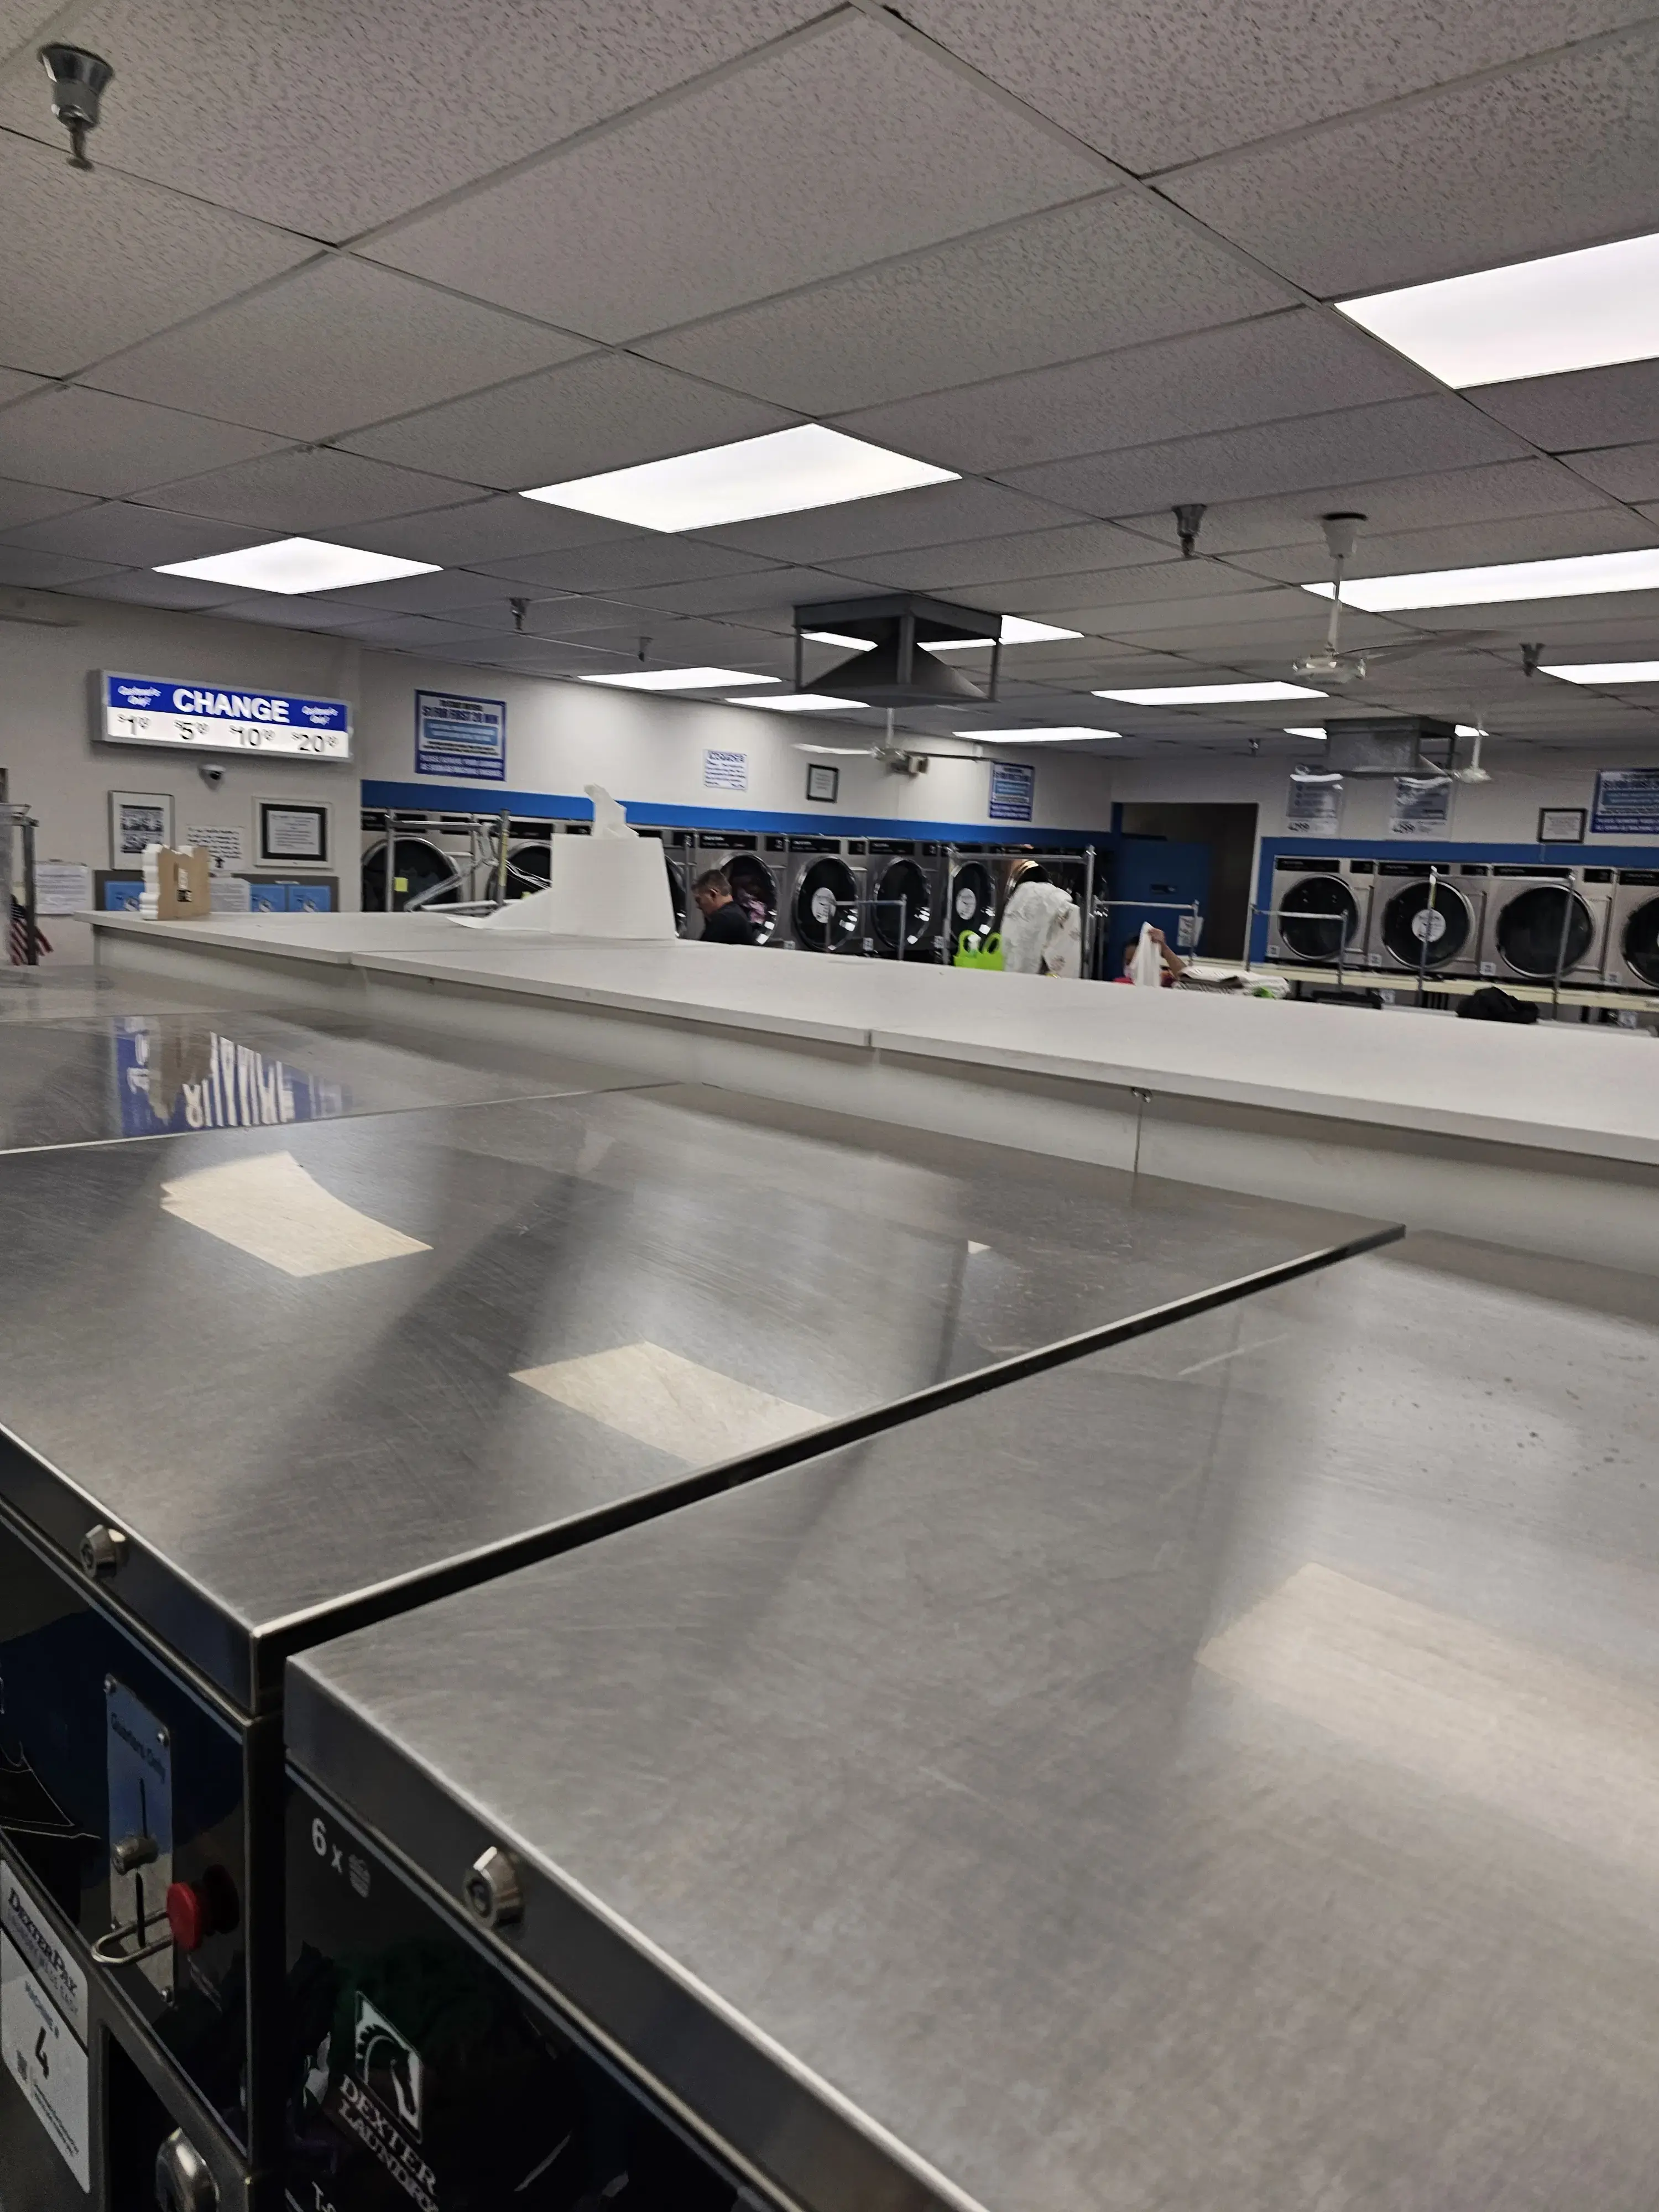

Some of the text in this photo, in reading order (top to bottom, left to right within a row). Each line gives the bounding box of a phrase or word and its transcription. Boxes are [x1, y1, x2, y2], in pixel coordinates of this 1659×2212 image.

[173, 688, 290, 723] CHANGE
[35, 2026, 50, 2080] 4
[338, 2073, 436, 2197] DEXTER
